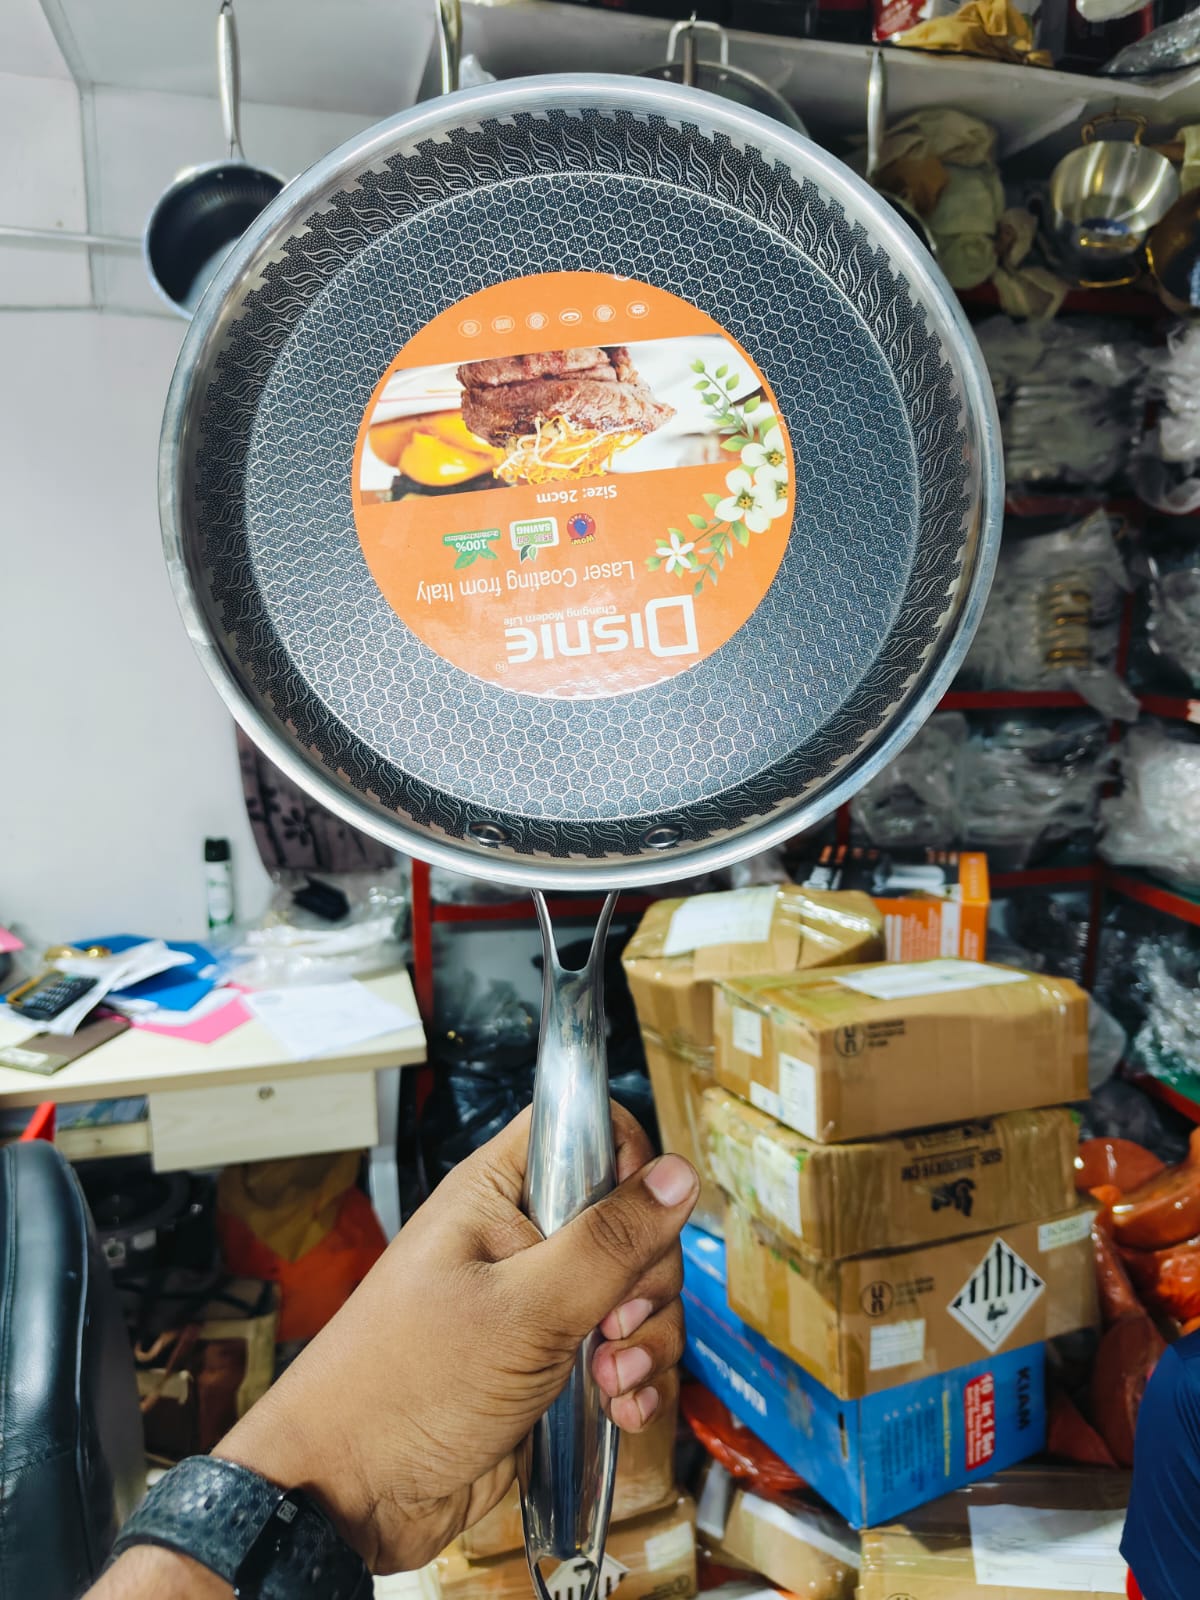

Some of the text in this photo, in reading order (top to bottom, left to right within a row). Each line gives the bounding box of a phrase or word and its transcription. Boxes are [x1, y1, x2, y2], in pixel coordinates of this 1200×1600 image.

[536, 485, 618, 504] Size: 26cm
[516, 522, 551, 535] SAVING
[455, 538, 487, 553] 100%
[416, 560, 635, 604] Laser Coating from Italy
[504, 605, 617, 626] Changing Modern Life
